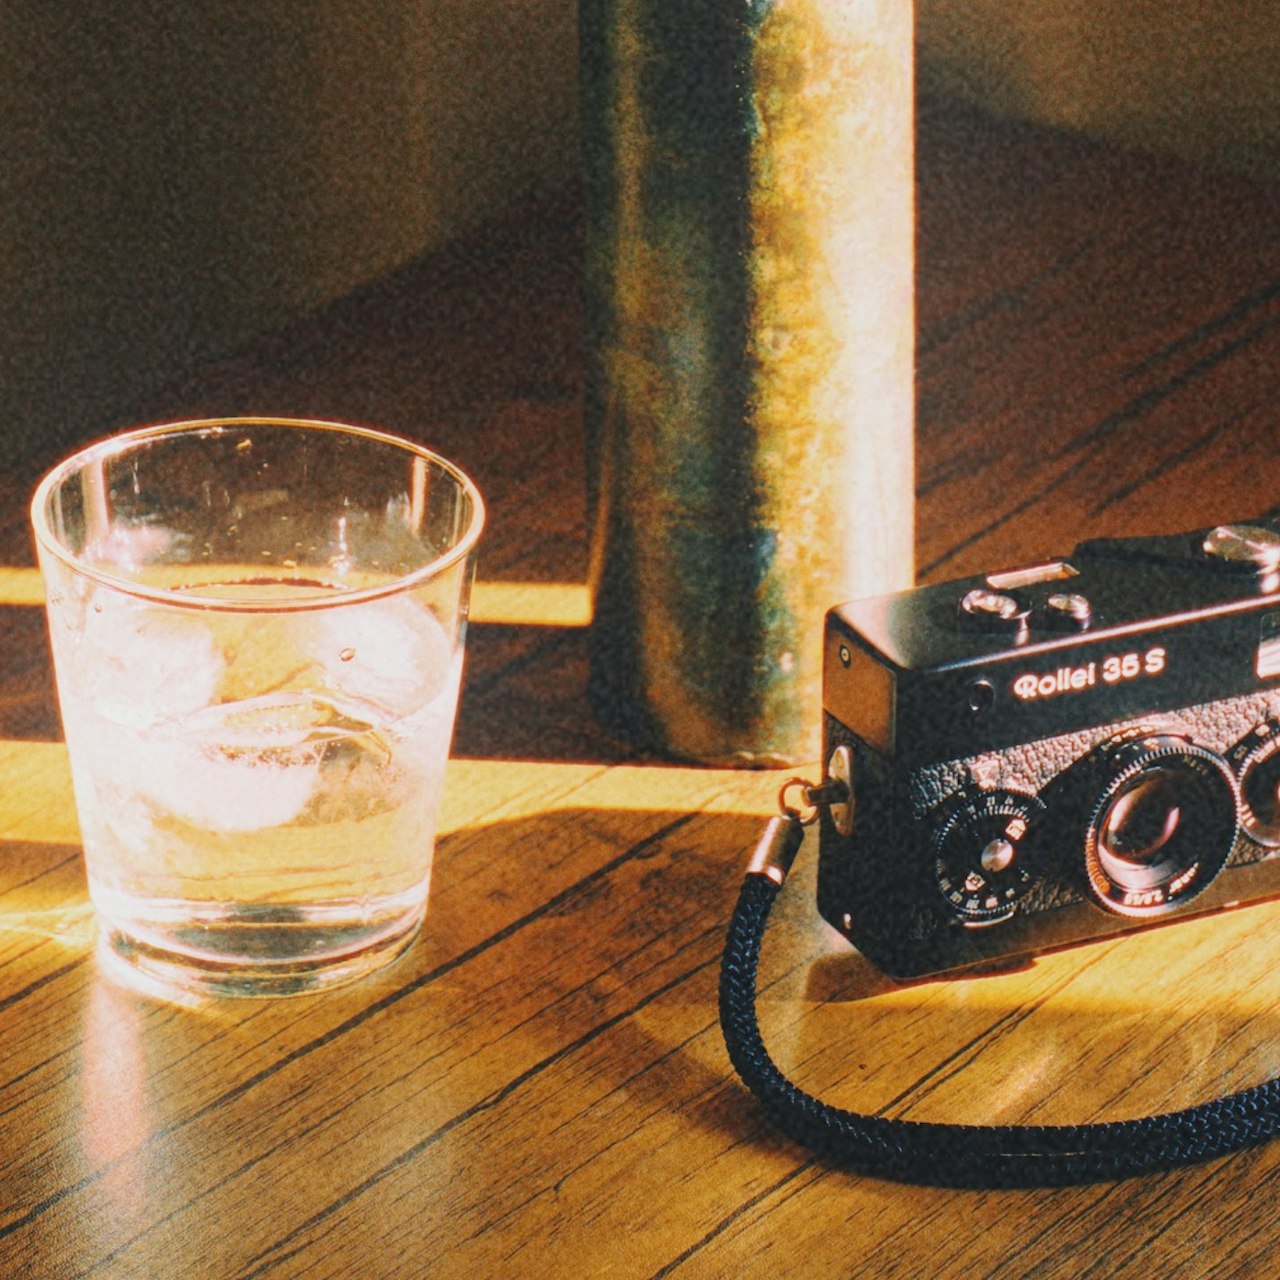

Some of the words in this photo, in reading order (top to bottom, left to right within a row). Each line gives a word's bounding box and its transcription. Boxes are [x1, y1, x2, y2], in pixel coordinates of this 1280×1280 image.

[1013, 661, 1096, 699] Rollei
[1102, 652, 1140, 683] 35
[1144, 646, 1166, 674] S
